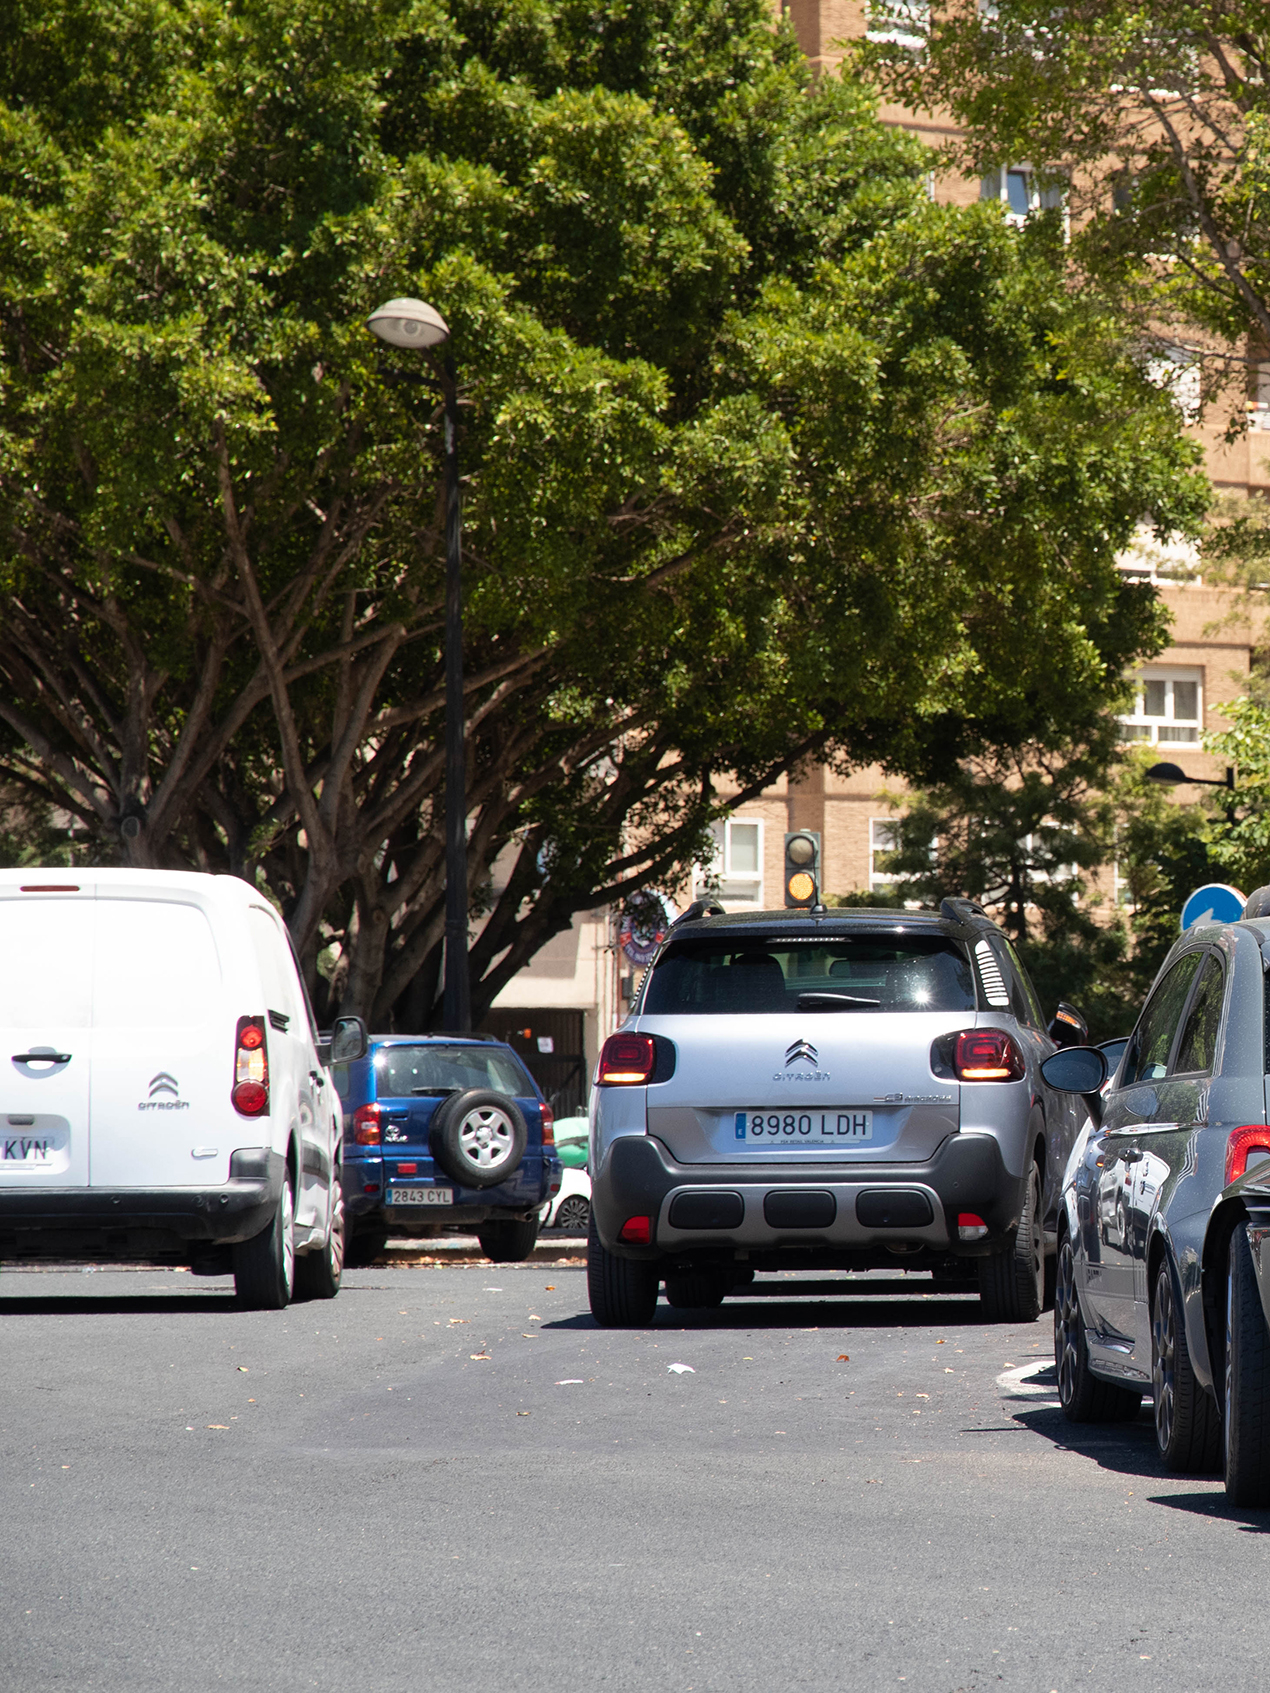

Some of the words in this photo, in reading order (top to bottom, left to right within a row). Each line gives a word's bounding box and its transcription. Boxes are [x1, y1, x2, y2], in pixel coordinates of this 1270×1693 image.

[751, 1114, 812, 1136] 8980
[821, 1114, 867, 1136] LDH
[4, 1140, 47, 1160] KVN
[394, 1190, 424, 1203] 2843
[427, 1190, 450, 1203] CYL
